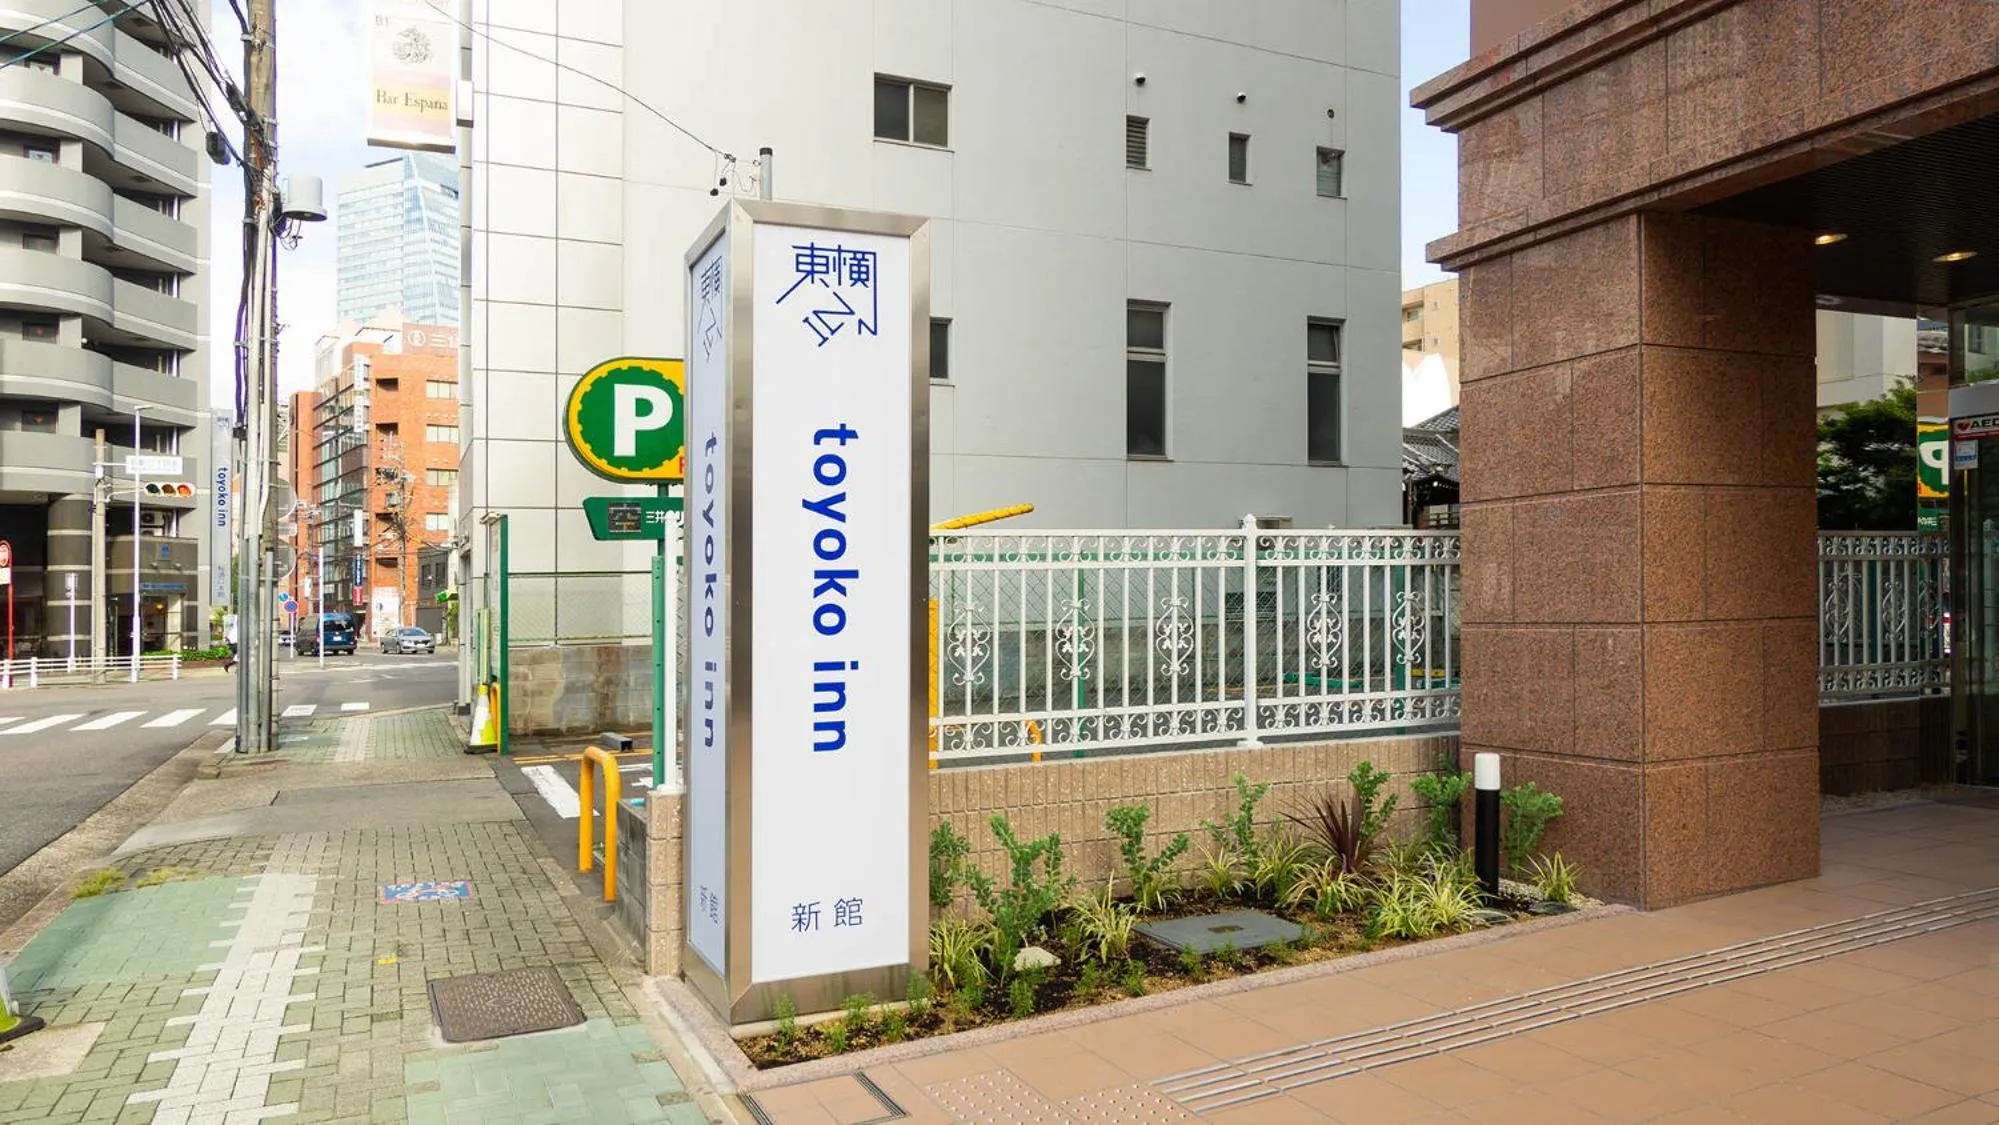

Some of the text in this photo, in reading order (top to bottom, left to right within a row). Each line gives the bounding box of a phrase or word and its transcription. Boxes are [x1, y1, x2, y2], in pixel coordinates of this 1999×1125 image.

[376, 88, 398, 106] Bar
[613, 383, 674, 457] P
[217, 466, 229, 528] toyoko inn
[702, 432, 718, 748] toyoko inn
[802, 423, 859, 752] toyoko inn
